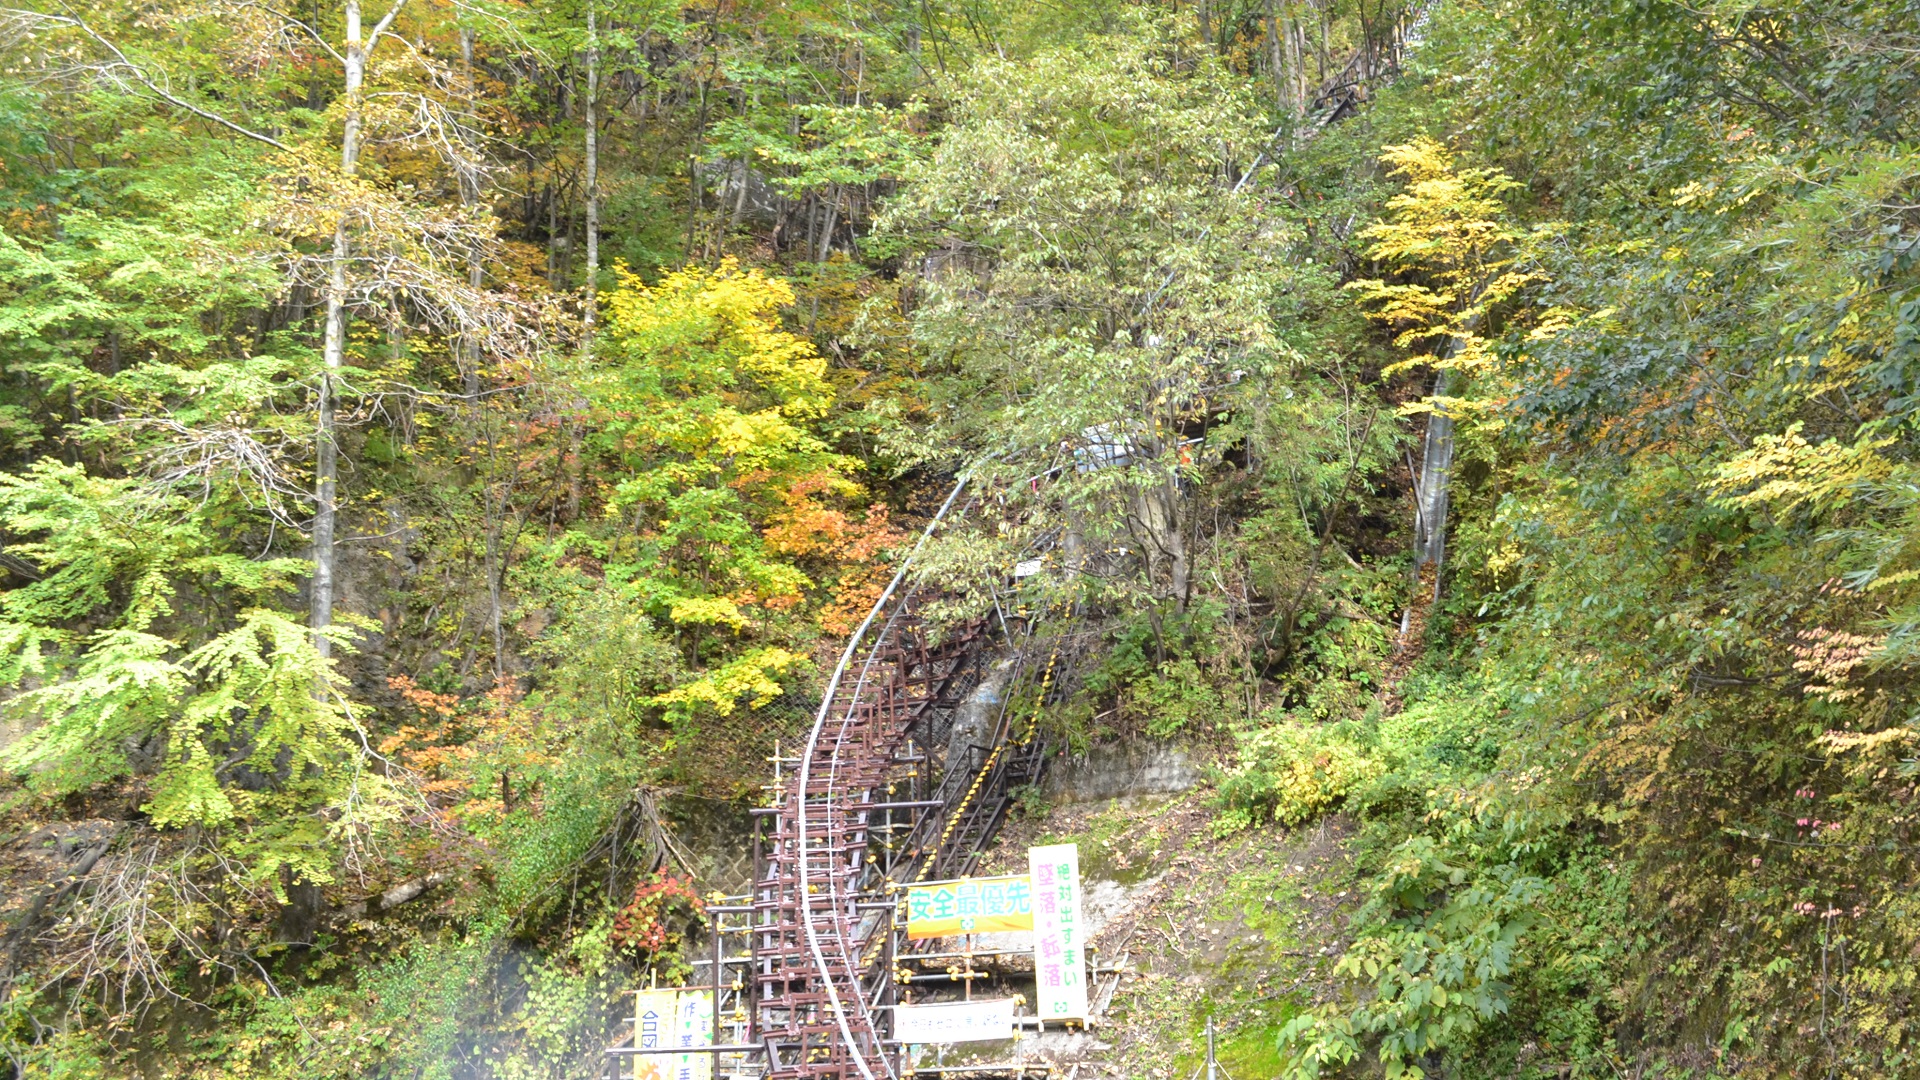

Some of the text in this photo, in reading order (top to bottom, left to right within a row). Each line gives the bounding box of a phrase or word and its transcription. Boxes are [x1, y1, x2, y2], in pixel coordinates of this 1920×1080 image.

[909, 881, 1031, 921] 安全最優先
[1057, 863, 1077, 986] 絶対出すまい
